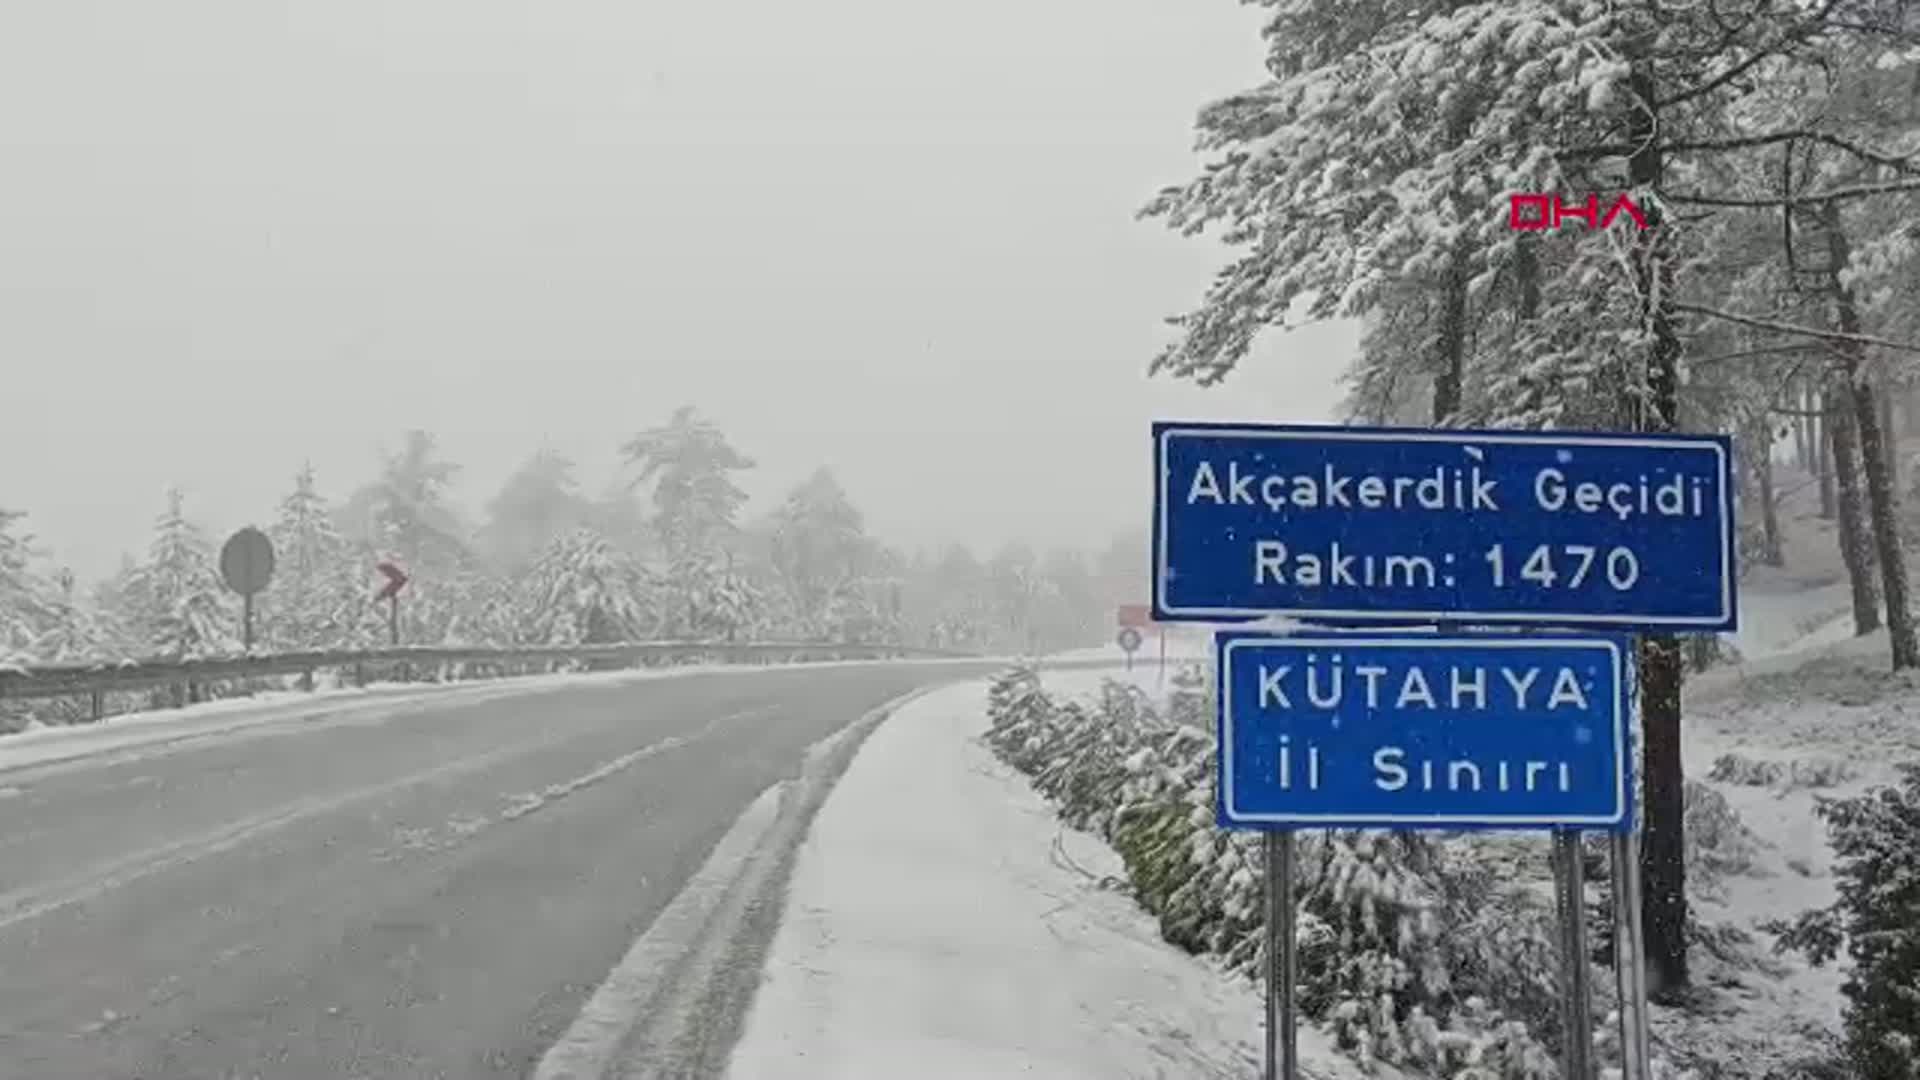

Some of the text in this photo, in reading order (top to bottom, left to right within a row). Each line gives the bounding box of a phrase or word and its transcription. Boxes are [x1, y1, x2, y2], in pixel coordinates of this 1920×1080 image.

[1187, 460, 1704, 518] Akçakerdik Geçidi
[1254, 540, 1640, 591] Rakım: 1470
[1258, 653, 1588, 709] KÜTAHYA
[1278, 734, 1570, 793] İl Sınırı
